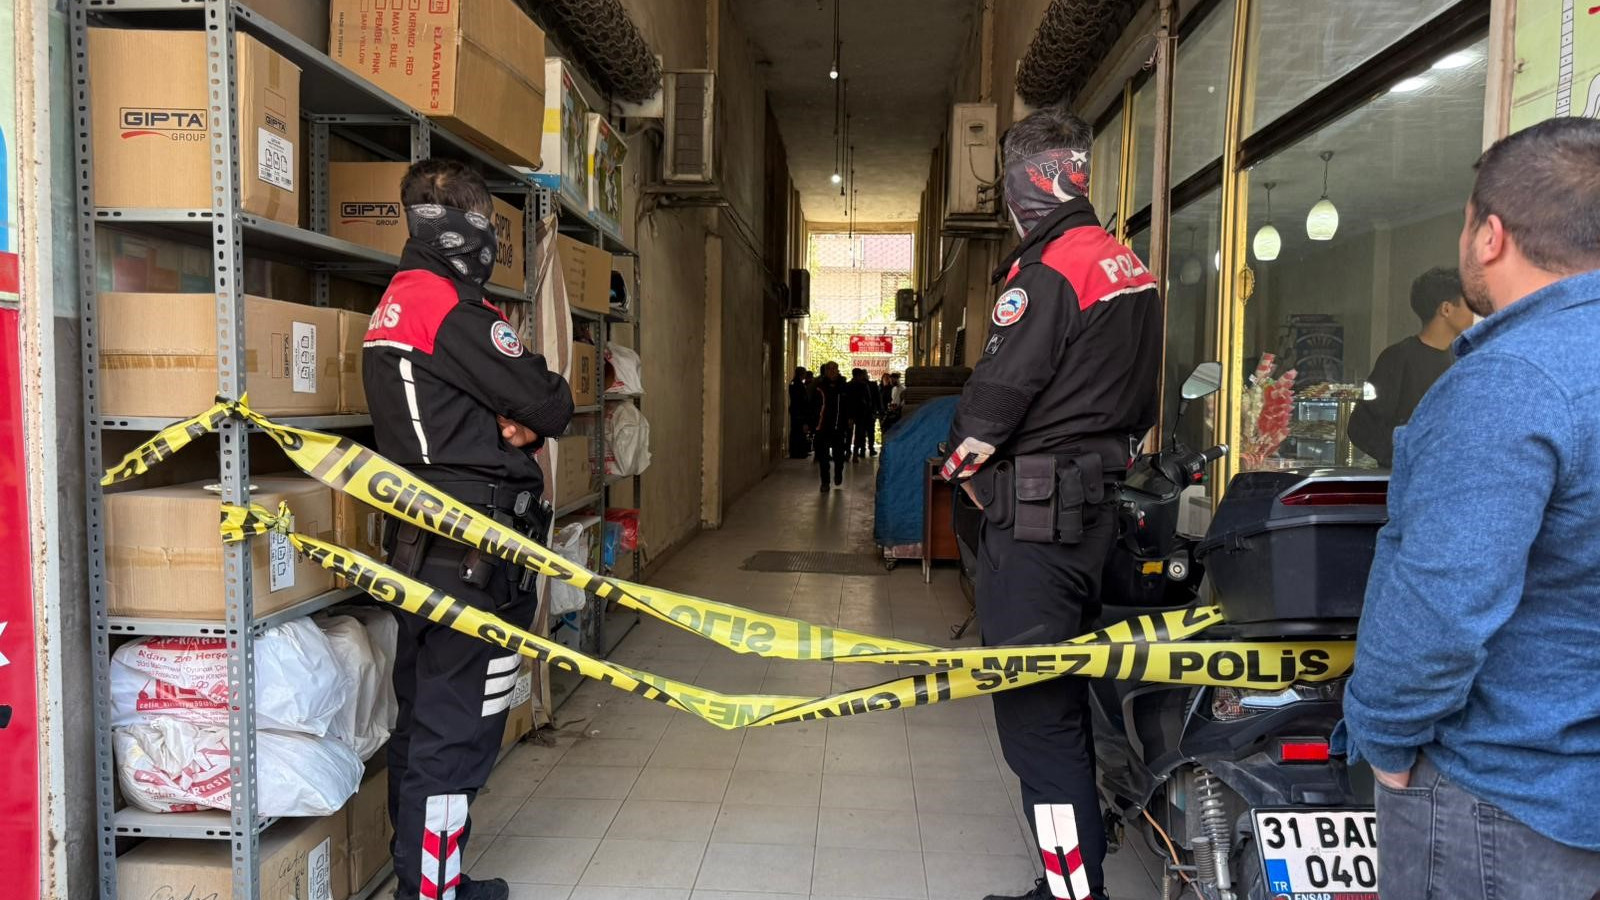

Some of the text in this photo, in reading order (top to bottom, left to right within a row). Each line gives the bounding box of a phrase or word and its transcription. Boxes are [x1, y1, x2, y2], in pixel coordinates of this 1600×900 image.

[374, 11, 384, 44] PEMBE
[371, 52, 381, 75] PINK
[389, 43, 398, 68] BLUE
[406, 57, 414, 76] RED
[124, 111, 204, 128] GIPTA
[265, 116, 287, 132] GIPTA
[171, 133, 206, 142] GROUP
[343, 204, 398, 216] GIPTA
[1263, 817, 1302, 849] 31
[1305, 855, 1377, 888] 040
[1273, 881, 1289, 892] TR
